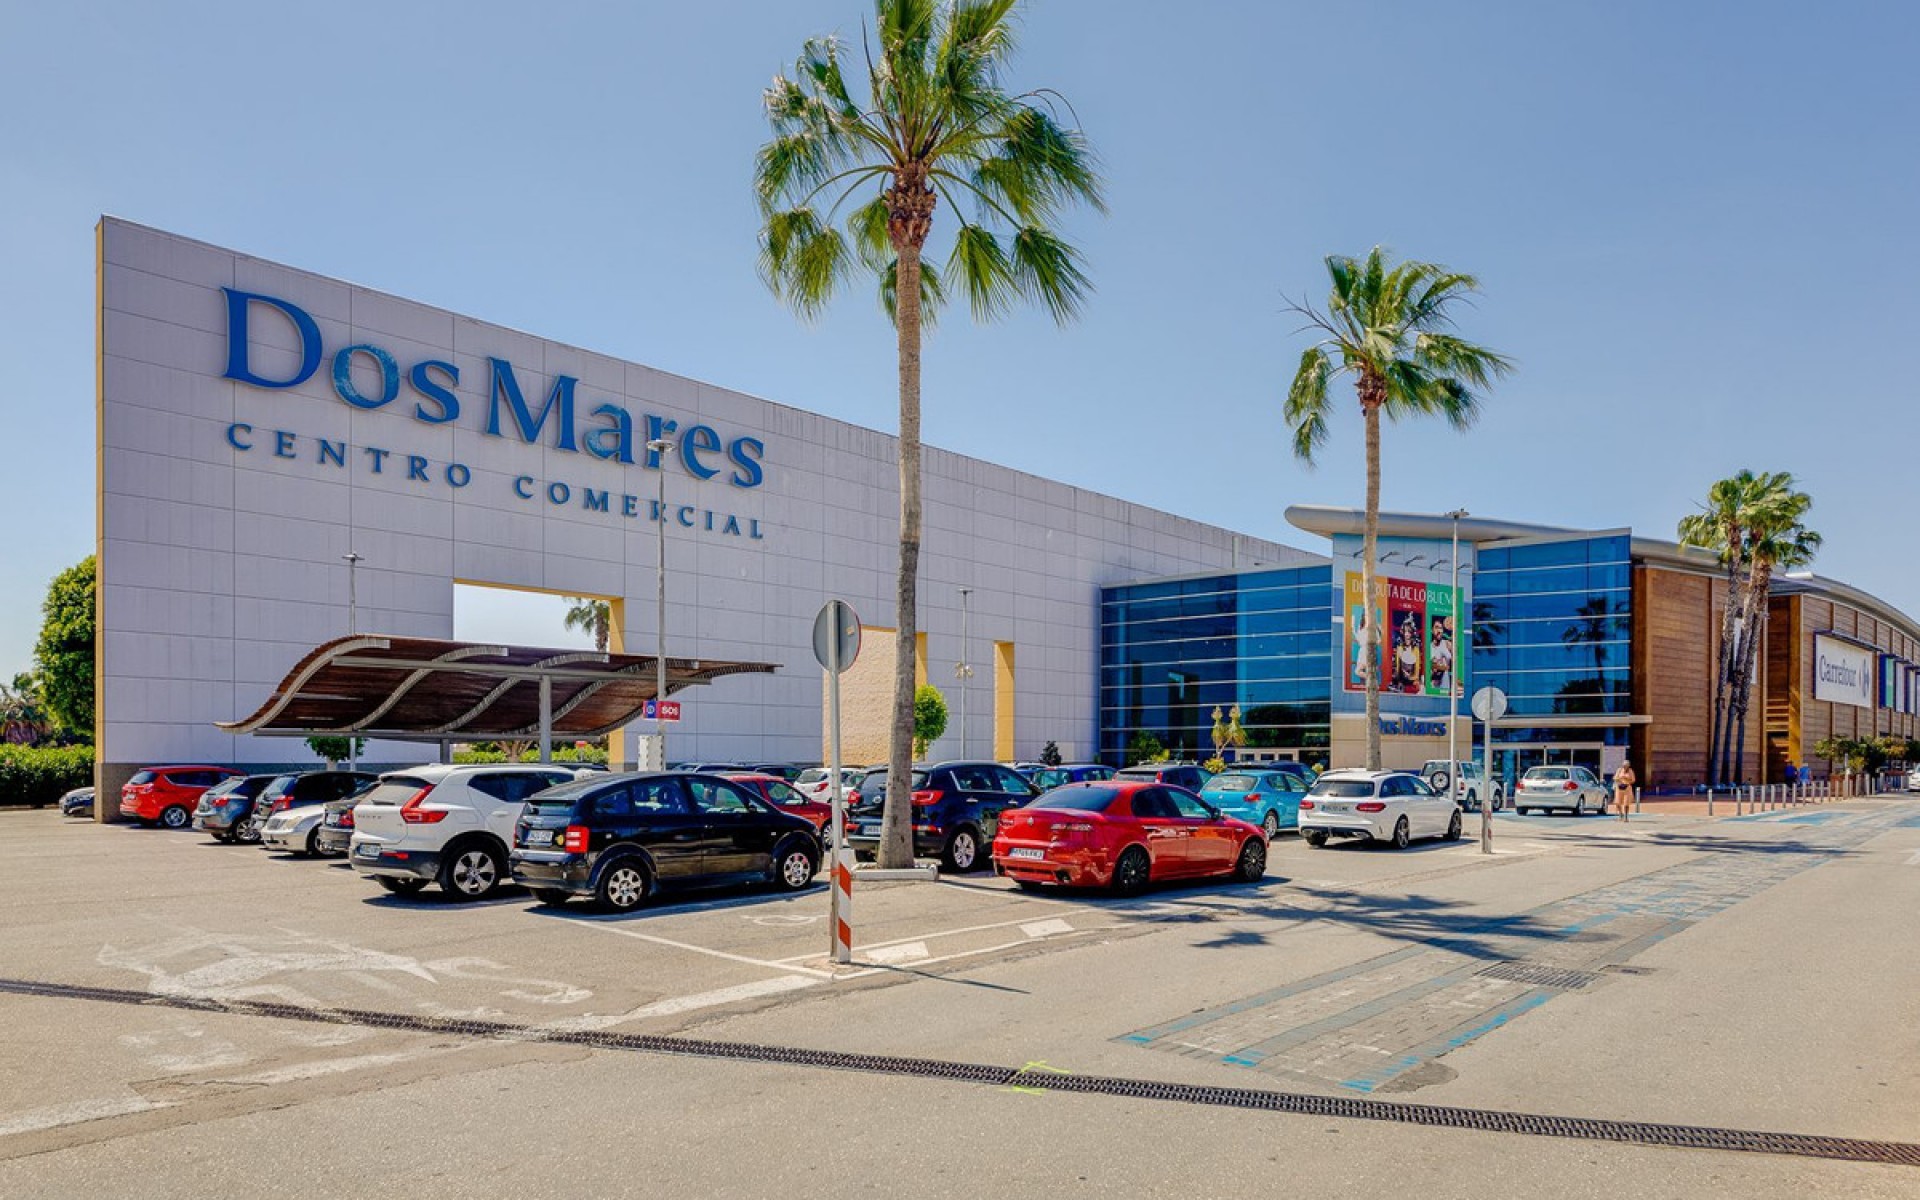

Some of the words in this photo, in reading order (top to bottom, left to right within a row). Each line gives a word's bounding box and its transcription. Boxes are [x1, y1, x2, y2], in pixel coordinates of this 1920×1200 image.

[221, 286, 460, 423] Dos
[486, 356, 765, 489] Mares
[227, 423, 471, 487] CENTRO
[514, 476, 764, 539] COMERCIAL
[661, 706, 678, 716] SOS
